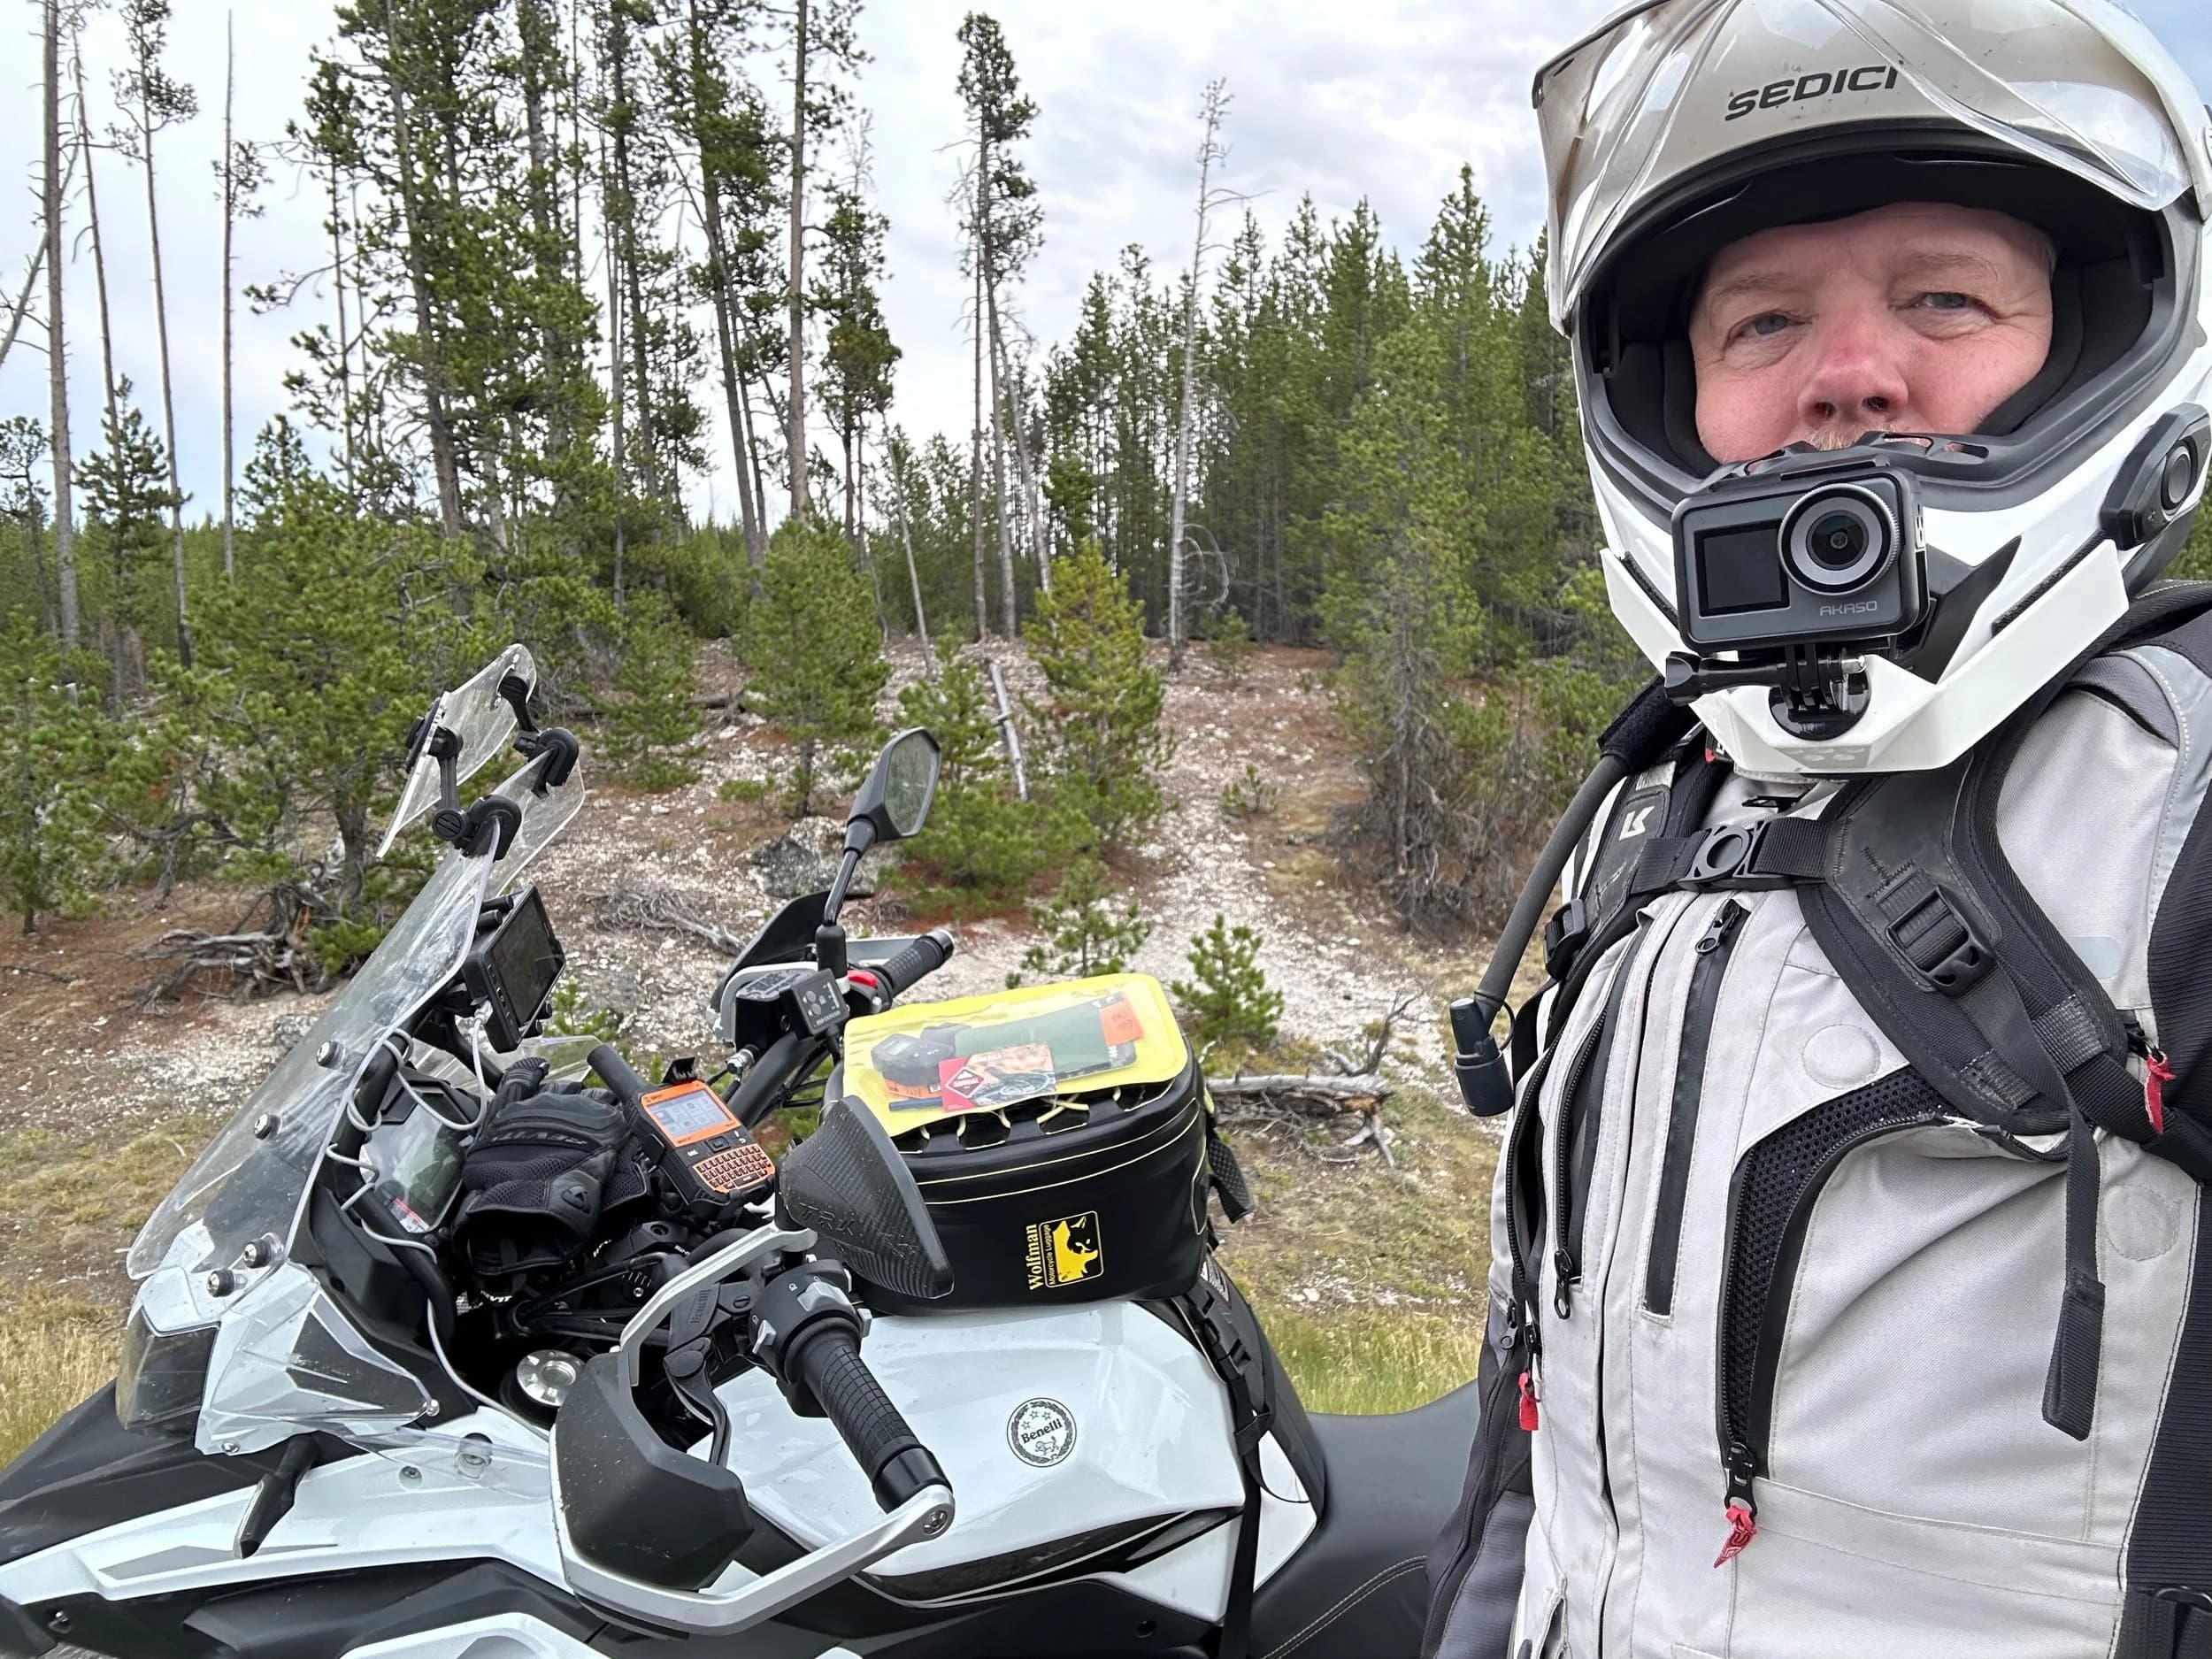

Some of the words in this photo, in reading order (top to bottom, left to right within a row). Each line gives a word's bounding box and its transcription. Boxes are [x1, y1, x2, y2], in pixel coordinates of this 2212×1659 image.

[1724, 65, 1899, 121] SEDICI
[1819, 600, 1878, 616] AKASO
[1043, 1224, 1053, 1252] Luggage
[1025, 1224, 1044, 1291] Wolfman
[1046, 1251, 1056, 1285] Motorcycle
[1020, 1418, 1063, 1444] Benelli
